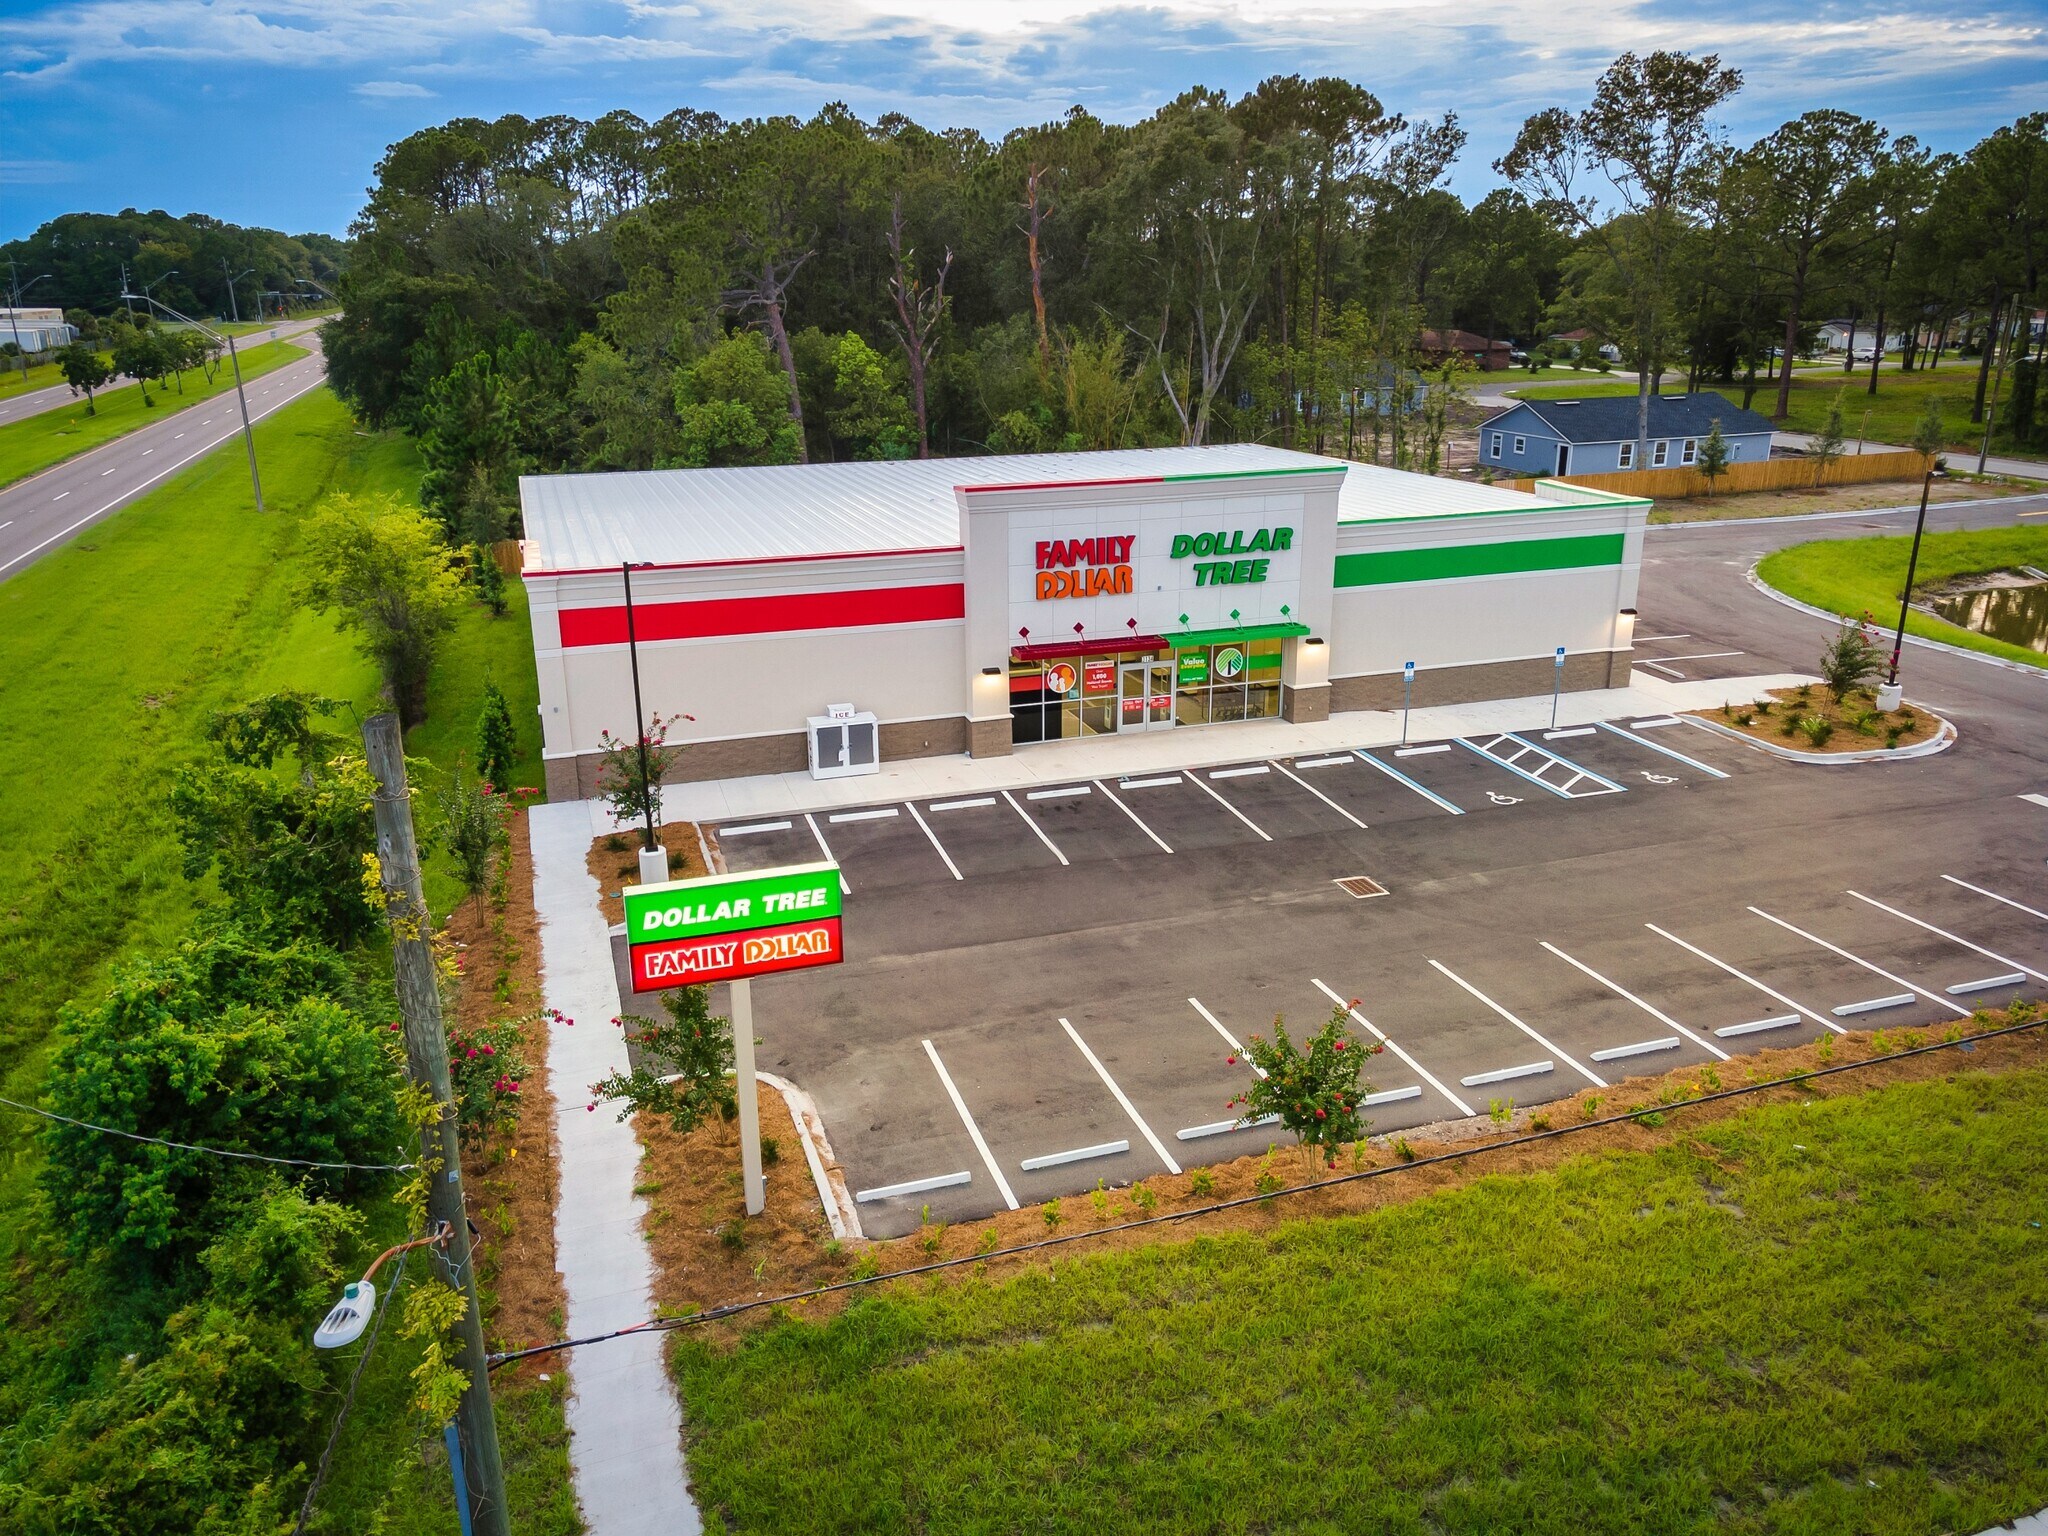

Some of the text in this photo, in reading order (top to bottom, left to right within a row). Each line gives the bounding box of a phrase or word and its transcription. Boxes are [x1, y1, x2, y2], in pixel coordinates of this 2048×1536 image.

[1035, 535, 1136, 569] FAMILY
[1170, 527, 1294, 559] DOLLAR
[1036, 565, 1133, 600] DOLLAR
[1193, 559, 1270, 586] TREE
[643, 888, 827, 930] DOLLAR TREE
[645, 929, 830, 979] FAMILY DOLLAR
